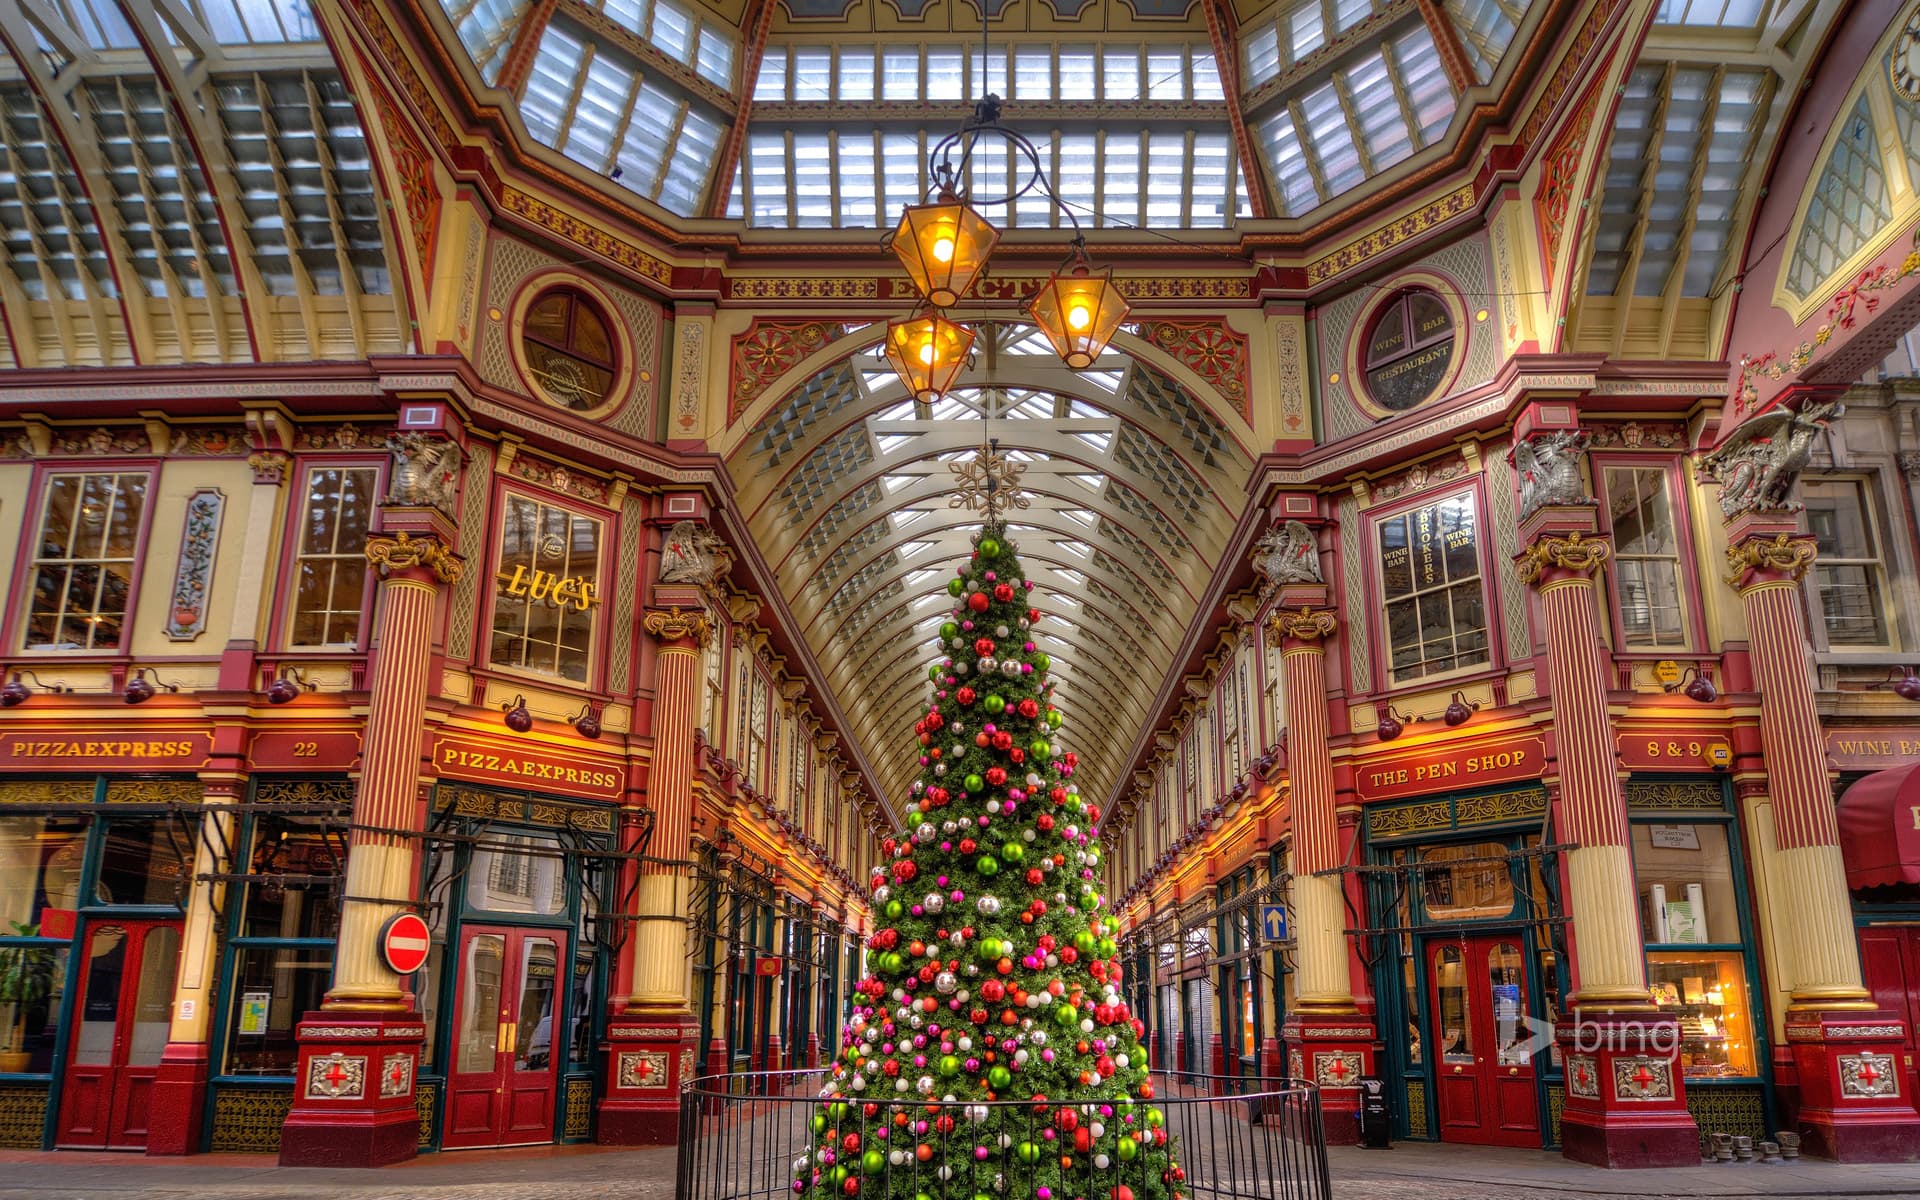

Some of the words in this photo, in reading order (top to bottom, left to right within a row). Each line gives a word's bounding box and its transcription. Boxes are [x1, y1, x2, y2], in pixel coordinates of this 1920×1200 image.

[1376, 335, 1404, 351] WINE
[1423, 316, 1446, 331] BAR
[1378, 346, 1449, 381] RESTAURANT
[1445, 527, 1473, 542] WINE
[1420, 510, 1434, 584] BROKERS
[1450, 537, 1469, 549] BAR
[1383, 547, 1408, 561] WINE
[1387, 556, 1405, 568] BAR
[506, 564, 594, 611] LUC'S
[11, 741, 193, 757] PIZZAEXPRESS
[293, 742, 318, 757] 22
[1647, 741, 1660, 757] 8
[1667, 741, 1684, 757] &
[1688, 741, 1702, 757] 9
[1837, 740, 1893, 755] WINE
[443, 748, 616, 788] PIZZAEXPRESS
[1370, 769, 1408, 787] THE
[1415, 761, 1458, 781] PEN
[1466, 750, 1526, 773] SHOP
